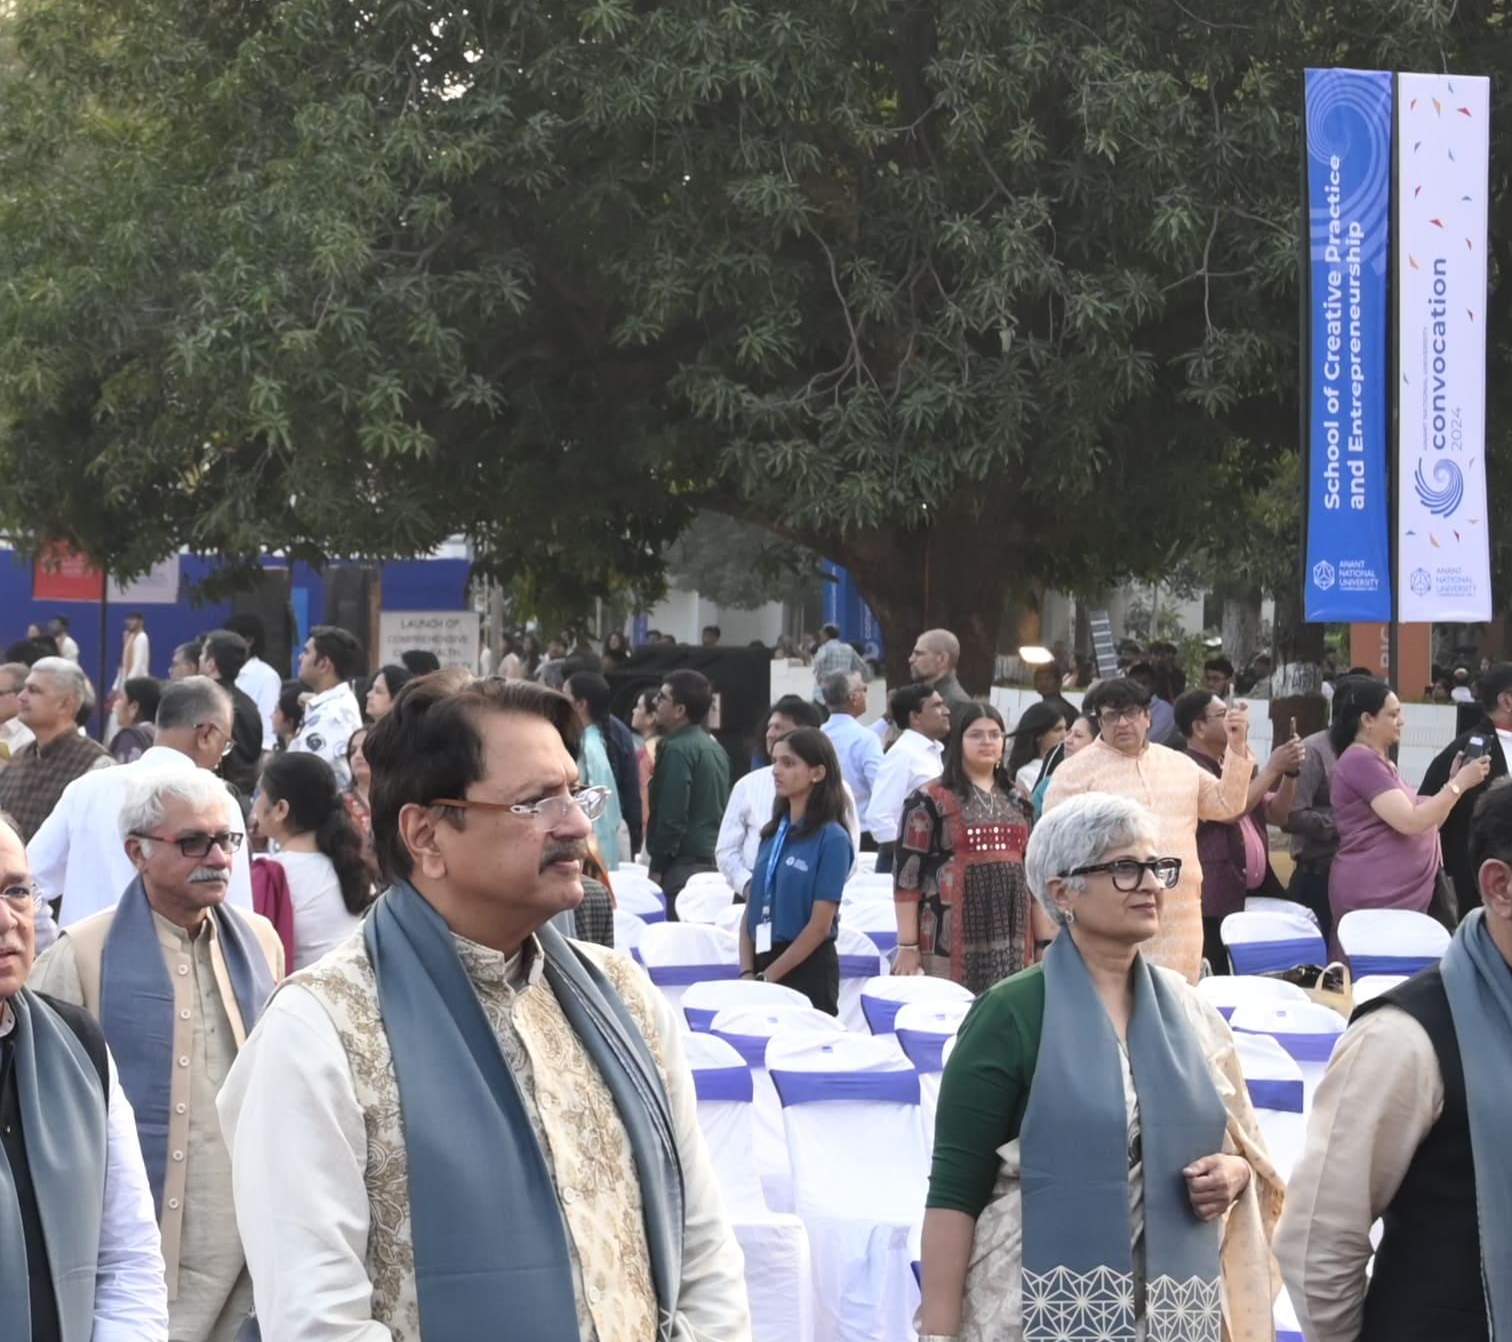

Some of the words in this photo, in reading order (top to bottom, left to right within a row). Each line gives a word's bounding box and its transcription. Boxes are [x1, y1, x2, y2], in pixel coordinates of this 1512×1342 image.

[1324, 154, 1341, 263] Practice
[1323, 270, 1342, 381] Creative
[1345, 221, 1365, 452] Entrepreneurship
[1428, 258, 1446, 450] convocation
[1323, 386, 1339, 414] of
[1451, 406, 1462, 452] 2024
[1323, 421, 1340, 510] School
[1347, 460, 1365, 510] and
[1339, 560, 1365, 569] ANANT
[1339, 569, 1375, 578] NATIONAL
[1339, 579, 1379, 587] UNIVERSITY
[387, 634, 468, 644] COMPREHENSIVE
[401, 619, 443, 629] LAUNCH
[446, 618, 460, 628] OF
